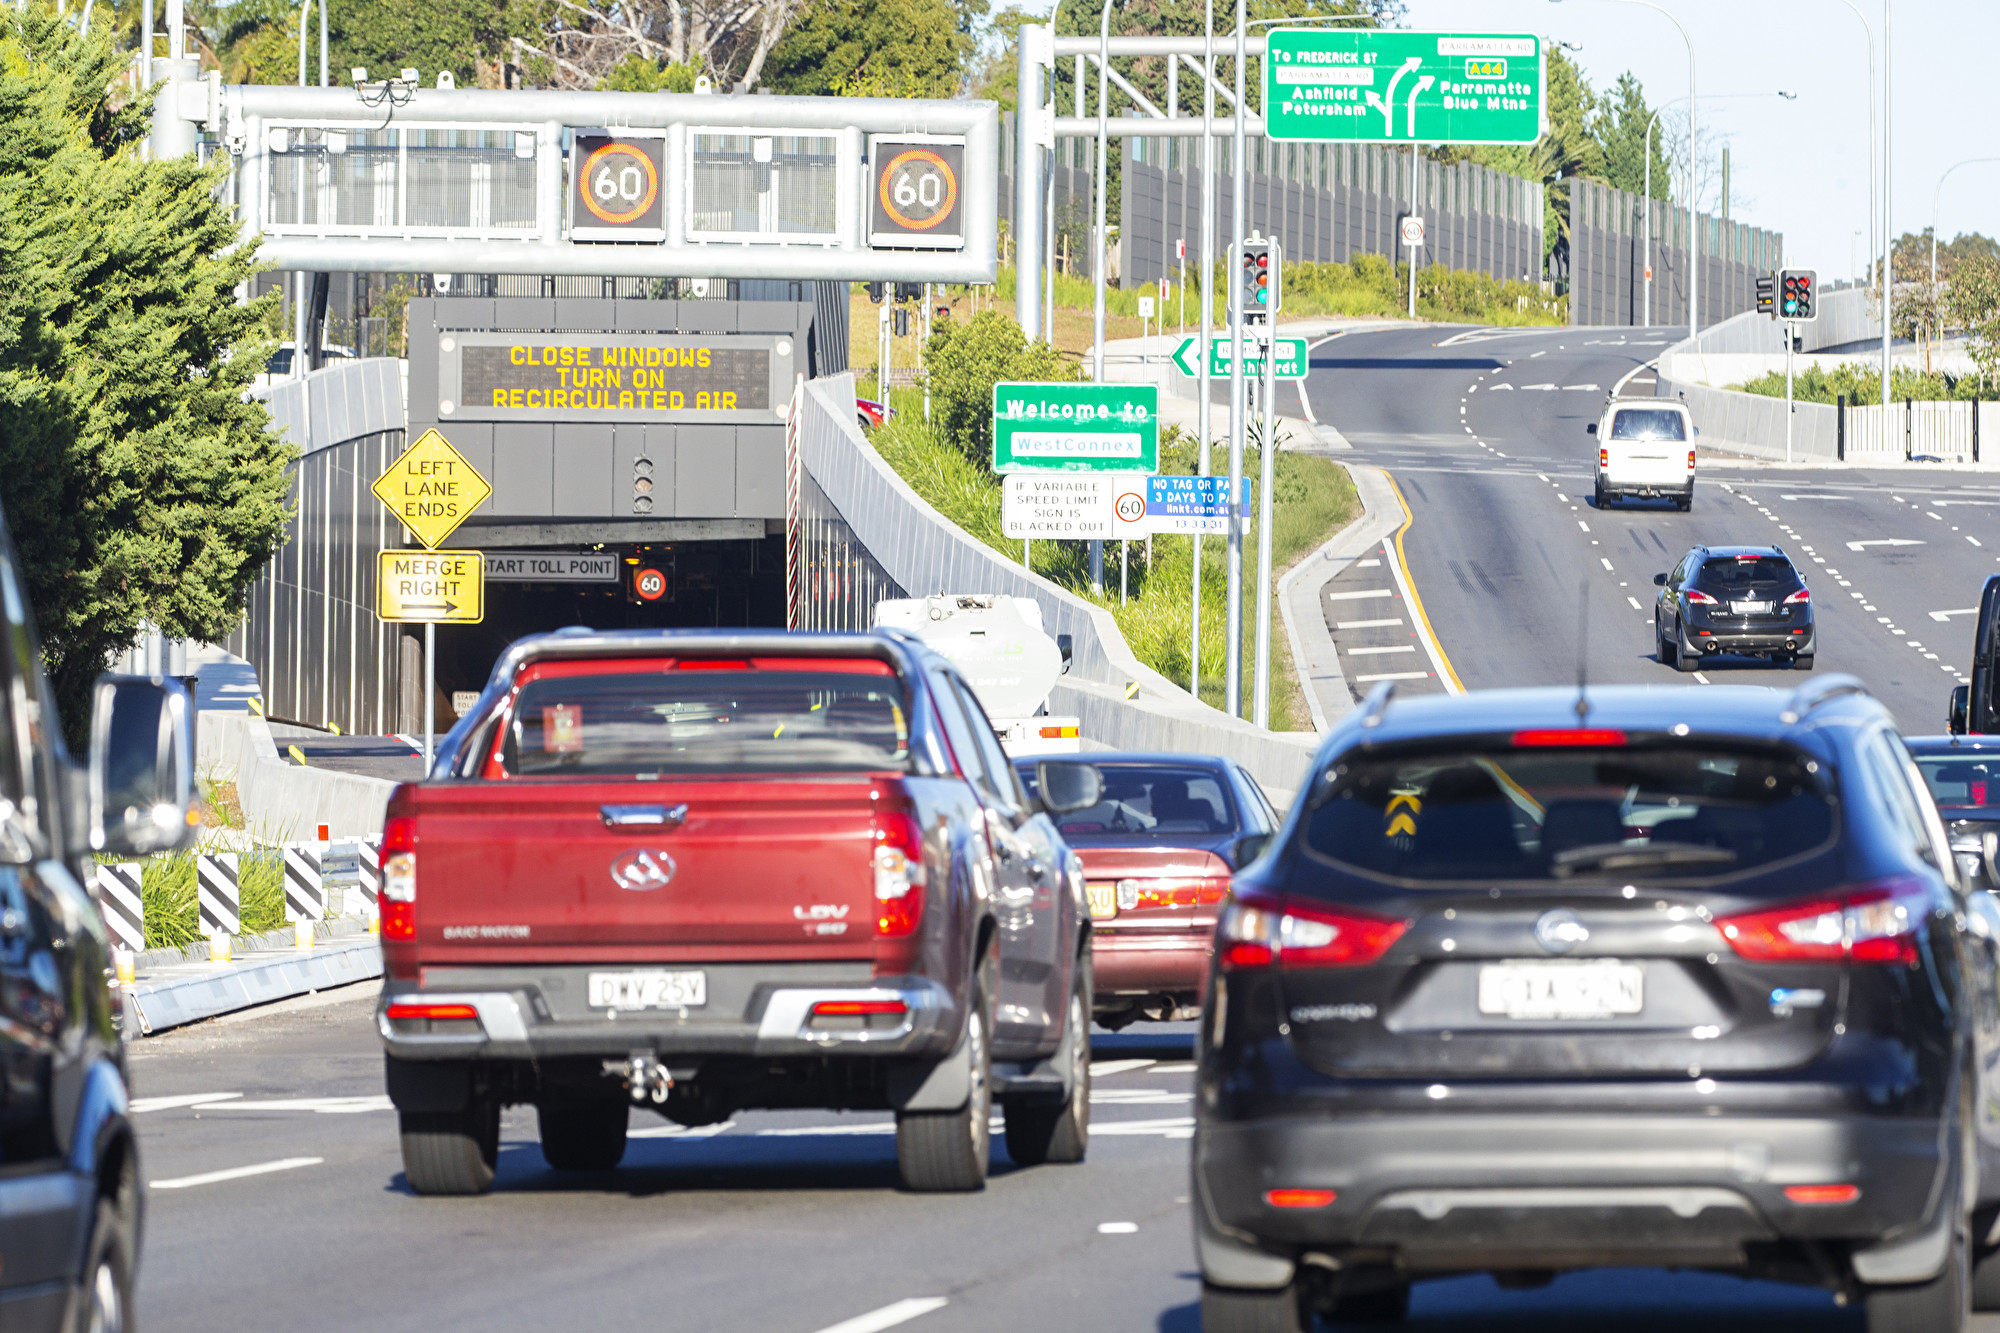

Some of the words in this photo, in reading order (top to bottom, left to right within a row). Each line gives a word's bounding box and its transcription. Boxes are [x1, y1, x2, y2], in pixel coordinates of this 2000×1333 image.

[1272, 49, 1291, 62] To
[1296, 51, 1358, 63] FREDERICK
[1363, 52, 1378, 64] ST
[1470, 63, 1503, 75] A44
[1292, 86, 1358, 100] Ashfield
[1440, 81, 1531, 95] Parramatta
[1282, 101, 1367, 116] Petersham
[1443, 96, 1479, 110] Blue
[1487, 96, 1528, 110] Mtns
[594, 166, 641, 200] 60
[894, 173, 941, 206] 60
[510, 346, 591, 367] CLOSE
[603, 347, 711, 368] WINDOWS
[556, 368, 621, 388] TURN
[632, 370, 664, 389] ON
[493, 388, 685, 410] RECIRCULATED
[697, 391, 737, 411] AIR
[1006, 399, 1109, 418] Welcome
[1124, 401, 1147, 419] to
[1018, 438, 1134, 451] WestConnex
[408, 461, 456, 475] LEFT
[405, 481, 458, 496] LANE
[1016, 482, 1025, 490] IF
[1034, 482, 1099, 492] VARIABLE
[1153, 479, 1167, 490] NO
[1172, 479, 1193, 490] TAG
[1197, 479, 1211, 490] OR
[1017, 495, 1059, 505] SPEED
[1066, 496, 1098, 505] LIMIT
[1155, 492, 1162, 502] 3
[1167, 492, 1196, 503] DAYS
[1201, 493, 1214, 503] TO
[405, 502, 457, 517] ENDS
[1034, 509, 1063, 518] SIGN
[1069, 509, 1081, 518] IS
[1120, 501, 1141, 514] 60
[1010, 522, 1072, 532] BLACKED
[1079, 522, 1104, 532] OUT
[395, 560, 466, 576] MERGE
[530, 560, 566, 574] TOLL
[569, 560, 612, 574] POINT
[400, 581, 461, 596] RIGHT
[641, 577, 660, 592] 60
